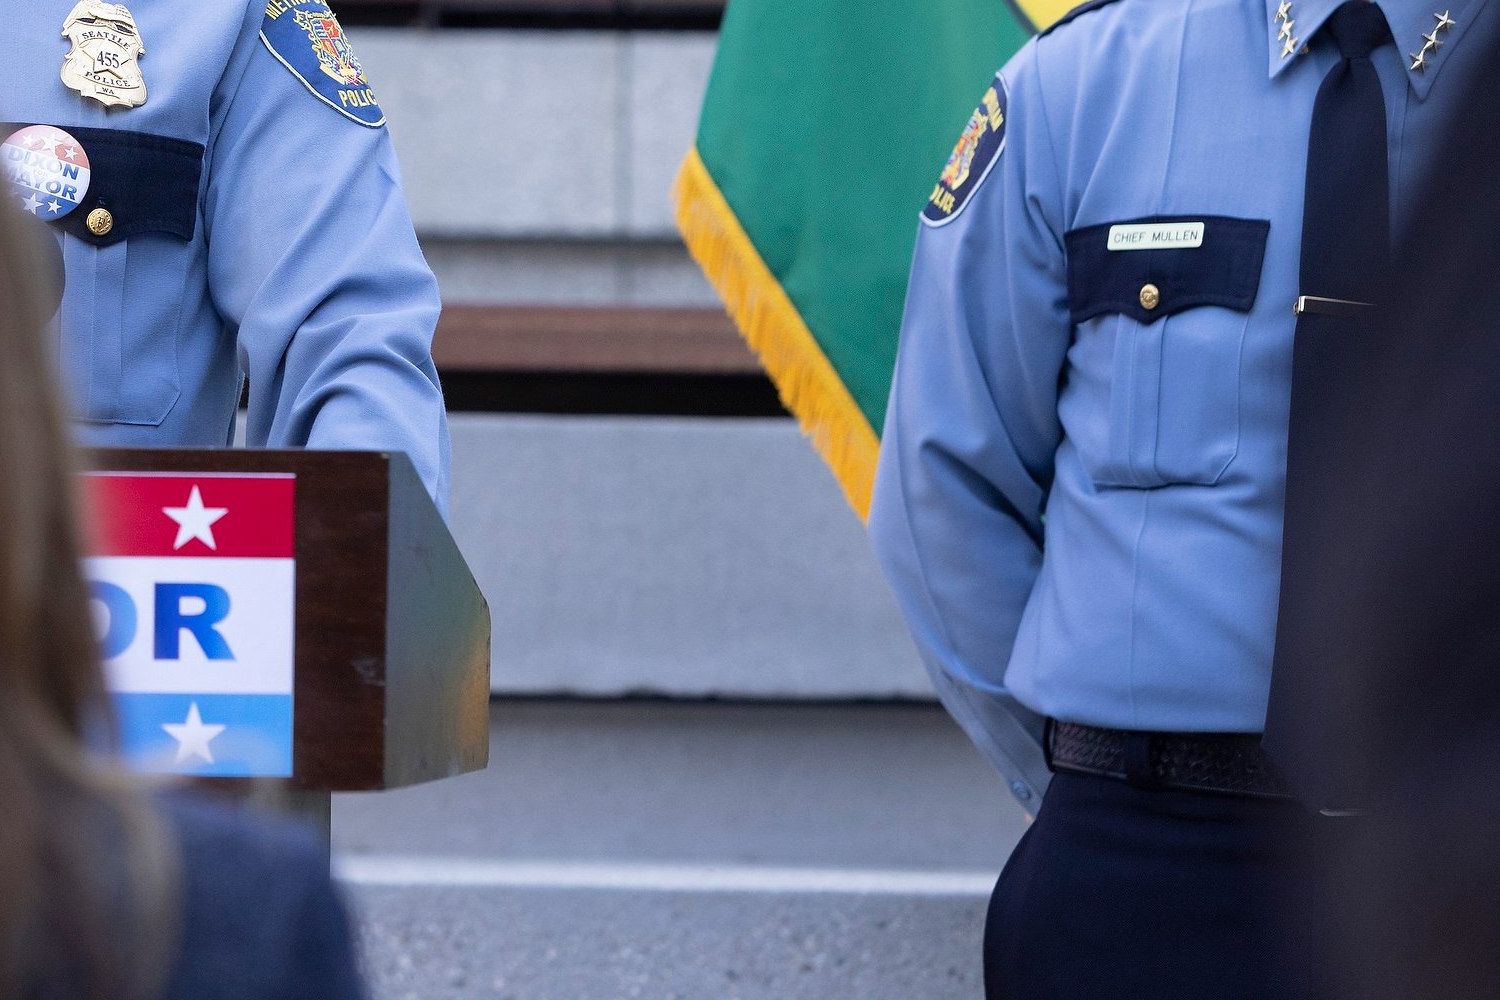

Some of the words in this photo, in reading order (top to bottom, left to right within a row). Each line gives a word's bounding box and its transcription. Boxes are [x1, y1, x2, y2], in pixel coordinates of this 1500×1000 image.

[81, 30, 131, 51] SEATTLE
[96, 50, 120, 69] 455
[84, 71, 131, 88] POLICE
[101, 87, 115, 95] WA
[8, 147, 80, 181] DIXON
[1113, 231, 1146, 244] CHIEF
[1151, 230, 1199, 241] MULLEN
